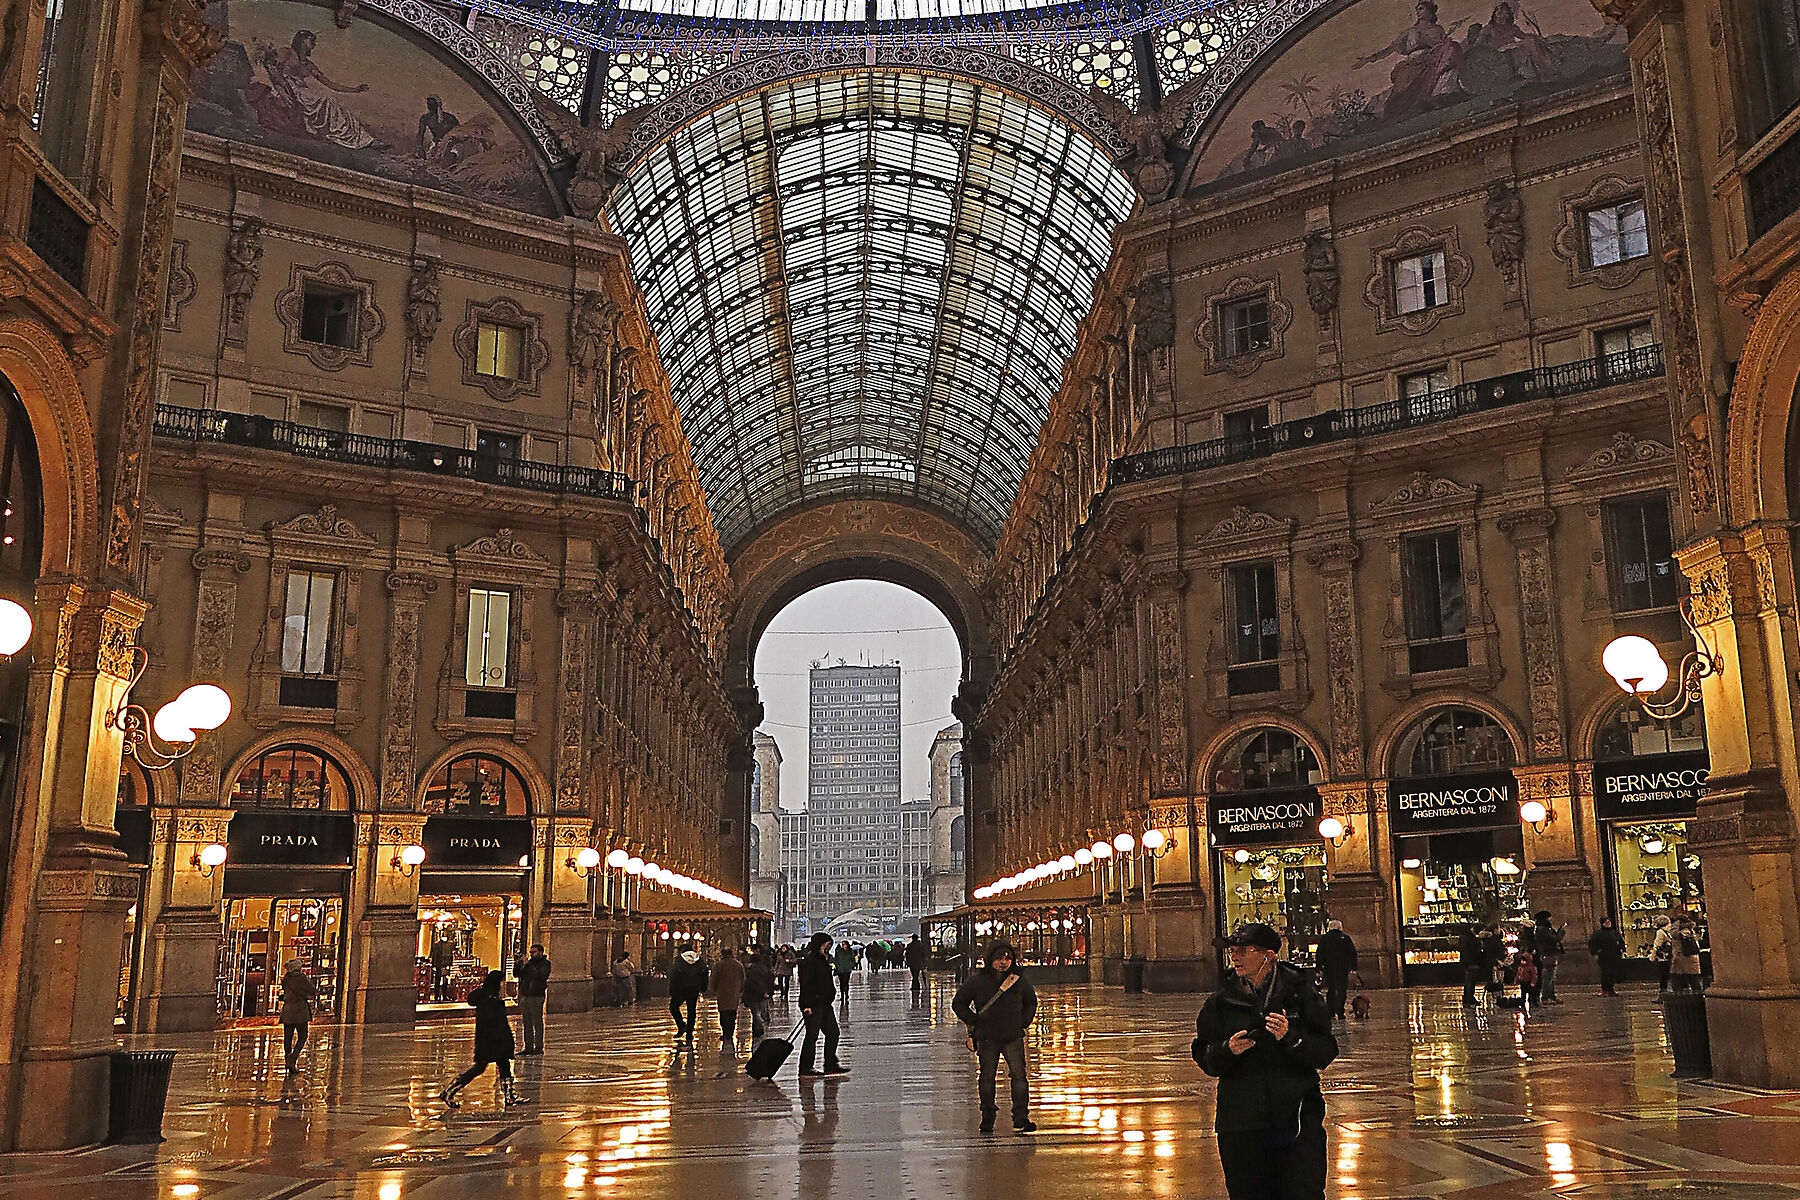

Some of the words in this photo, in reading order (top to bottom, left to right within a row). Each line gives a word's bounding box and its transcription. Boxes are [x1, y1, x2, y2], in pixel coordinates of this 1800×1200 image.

[1605, 768, 1710, 793] BERNASCO
[1399, 785, 1508, 810] BERNASCONI
[1621, 790, 1674, 803] ARGENTERIA
[1676, 789, 1692, 799] DAL
[1697, 788, 1711, 797] 187
[1218, 802, 1314, 824] BERNASCONI
[1461, 806, 1476, 815] DAL
[1479, 804, 1496, 813] 1872
[1272, 821, 1286, 829] DAL
[1288, 820, 1304, 828] 1872
[261, 835, 318, 846] PRADA
[450, 838, 500, 848] PRADA
